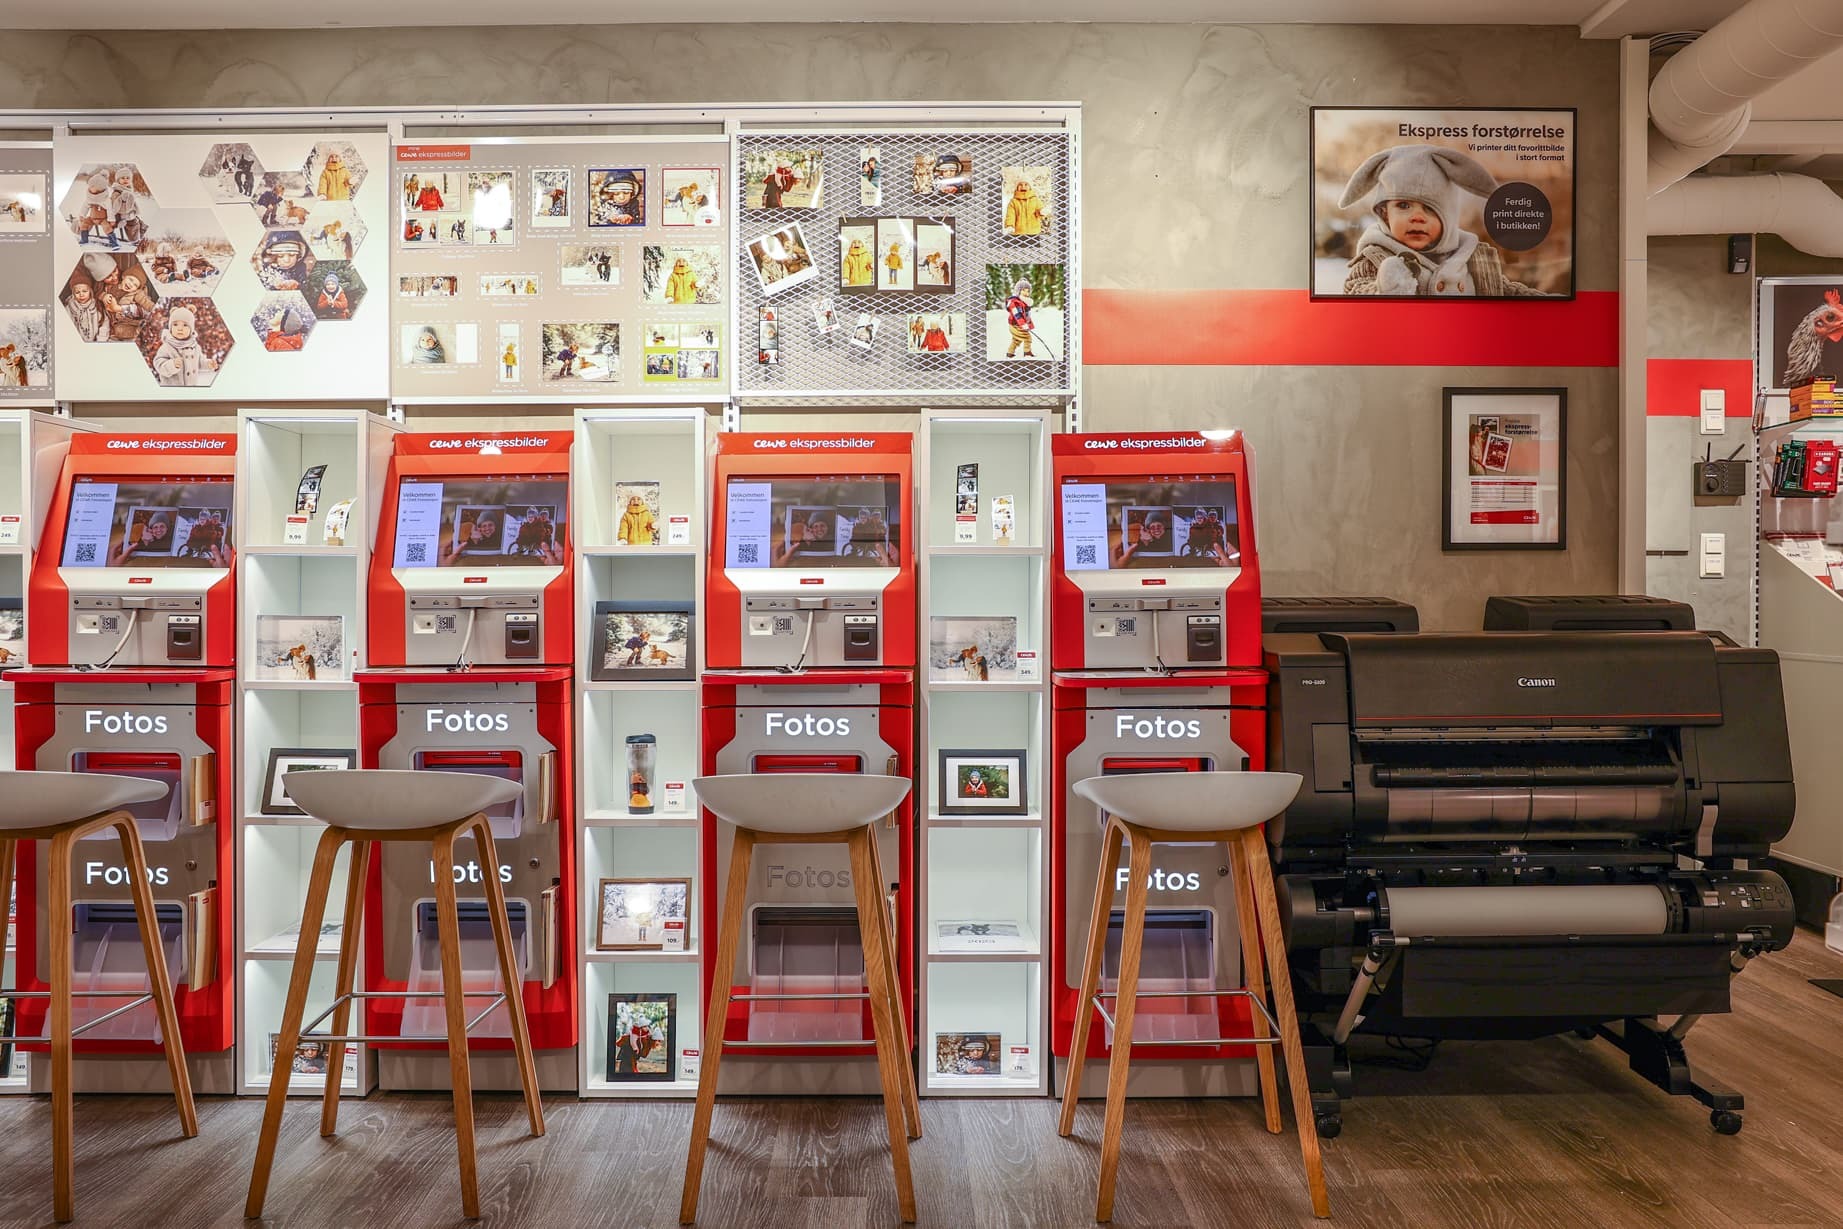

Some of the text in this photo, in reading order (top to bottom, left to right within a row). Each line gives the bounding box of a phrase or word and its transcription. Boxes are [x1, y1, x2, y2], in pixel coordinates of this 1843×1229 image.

[1398, 123, 1565, 139] Ekspress forstørrelse
[418, 151, 467, 159] ekspressbilder
[1477, 144, 1502, 153] printer
[1518, 144, 1565, 152] favorittbilde
[1505, 197, 1532, 208] Ferdig
[1492, 209, 1545, 219] print direkte
[1500, 221, 1541, 230] butikken!
[107, 438, 226, 451] cewe ekspressbilder
[429, 436, 549, 450] cewe ekspressbilder
[753, 437, 876, 451] cewe ekspressbilder
[1084, 436, 1207, 451] cewe ekspressbilder
[1517, 677, 1556, 688] Canon
[86, 710, 168, 734] Fotos
[427, 709, 508, 732] Fotos
[767, 712, 850, 736] Fotos
[1117, 715, 1201, 738] Fotos
[766, 865, 850, 888] Fotos
[1116, 868, 1200, 891] Ftos
